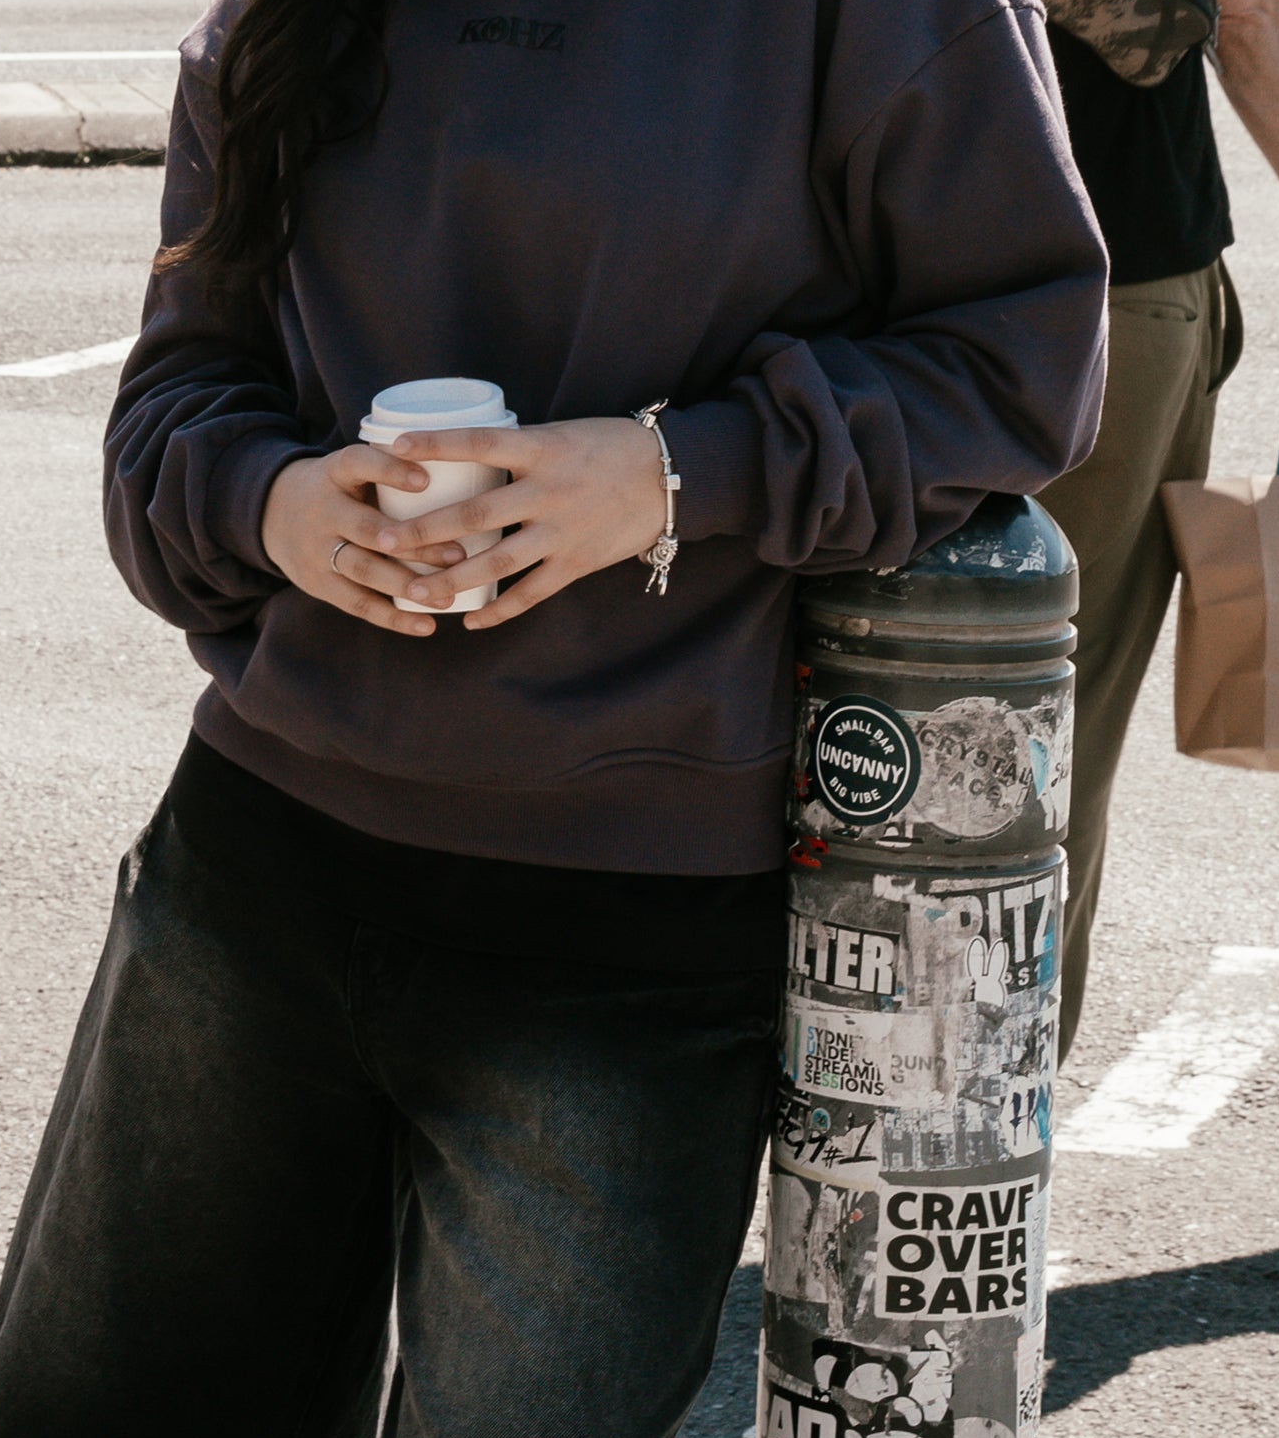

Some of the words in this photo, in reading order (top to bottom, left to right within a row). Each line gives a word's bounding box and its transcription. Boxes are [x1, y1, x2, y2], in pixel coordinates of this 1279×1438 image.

[835, 719, 872, 736] SMALL
[873, 729, 895, 755] BAR
[821, 742, 904, 784] UNCANNY
[829, 776, 848, 798] BIG
[851, 788, 881, 804] VIBE
[805, 1069, 884, 1096] SESSIONS
[886, 1227, 1027, 1273] OVER
[885, 1267, 1027, 1315] BARS
